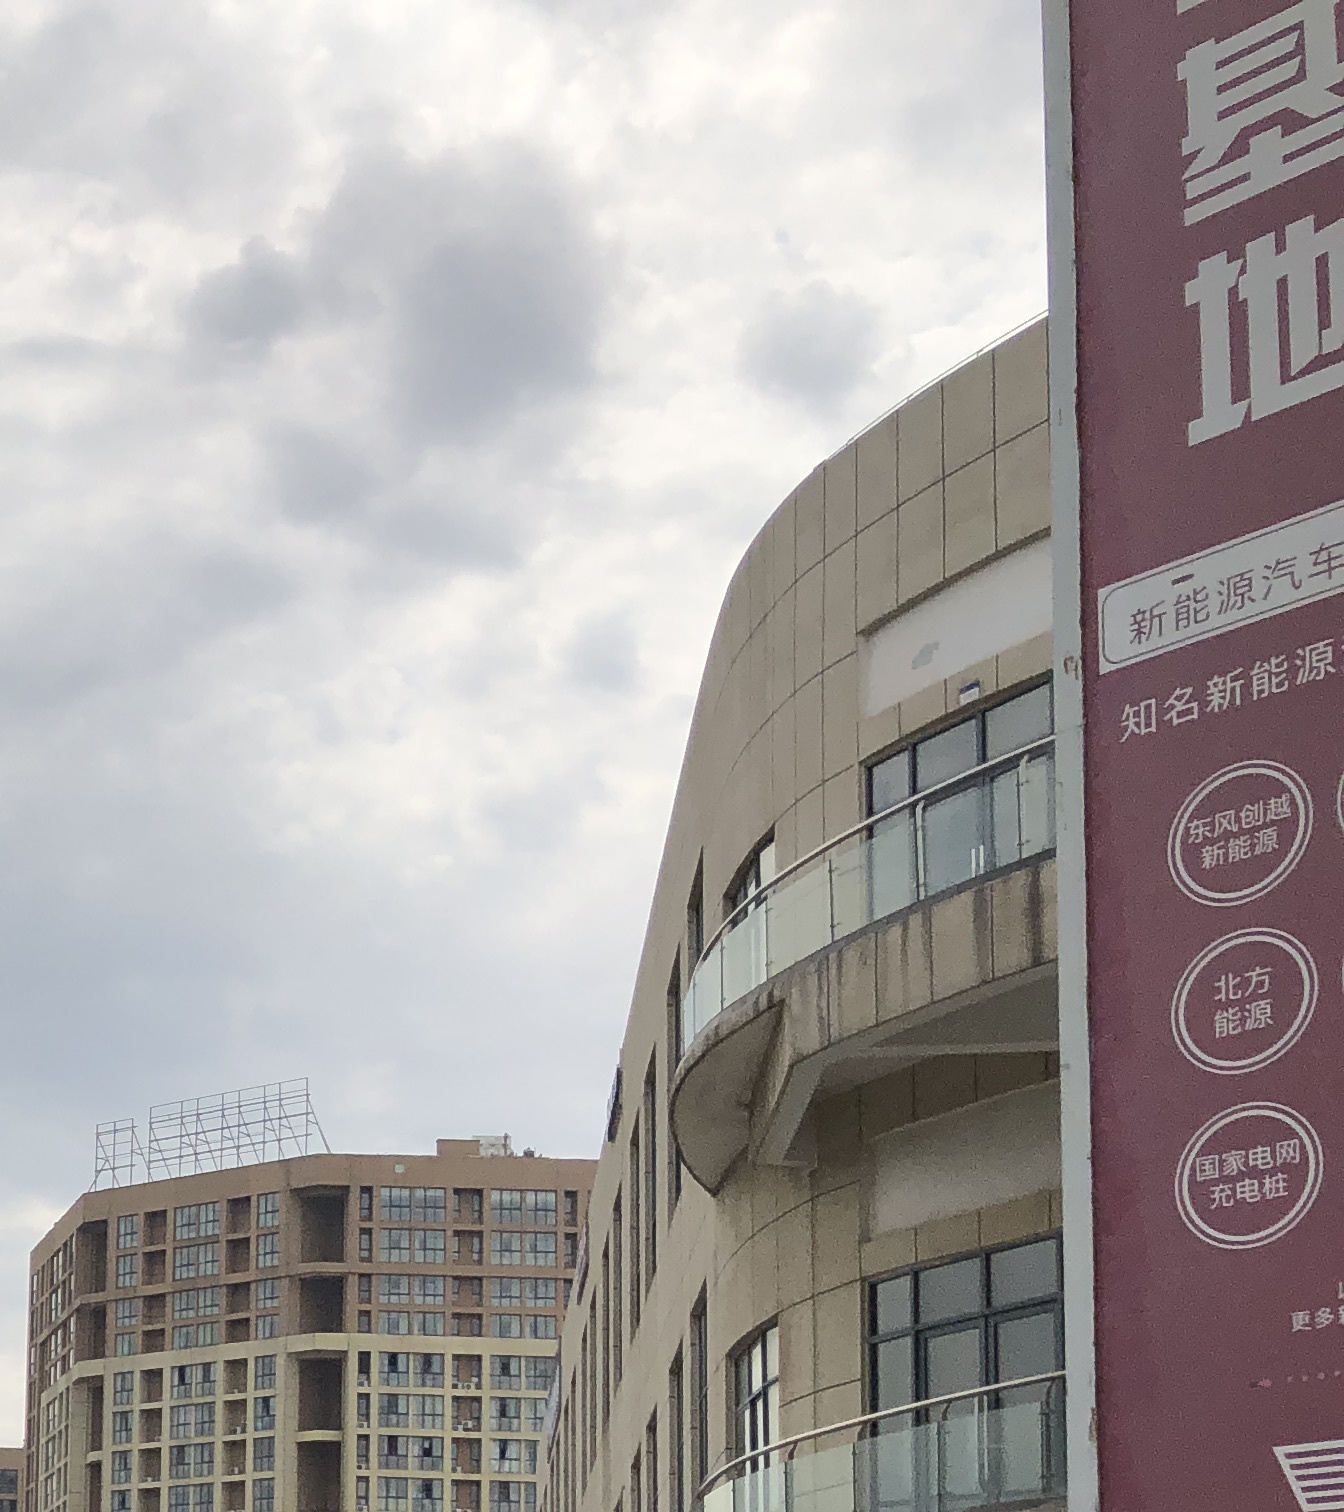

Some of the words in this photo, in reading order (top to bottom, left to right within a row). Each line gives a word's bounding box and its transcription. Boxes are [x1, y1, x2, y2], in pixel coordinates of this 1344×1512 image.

[1176, 0, 1344, 447] 基地
[1130, 541, 1344, 645] 新能源汽车
[1120, 638, 1344, 743] 知名新能源
[1187, 793, 1292, 844] 东风创越
[1201, 826, 1279, 869] 新能源
[1214, 966, 1273, 1001] 北方
[1214, 1001, 1274, 1038] 能源
[1196, 1139, 1300, 1182] 国家电网
[1210, 1173, 1289, 1209] 充电桩
